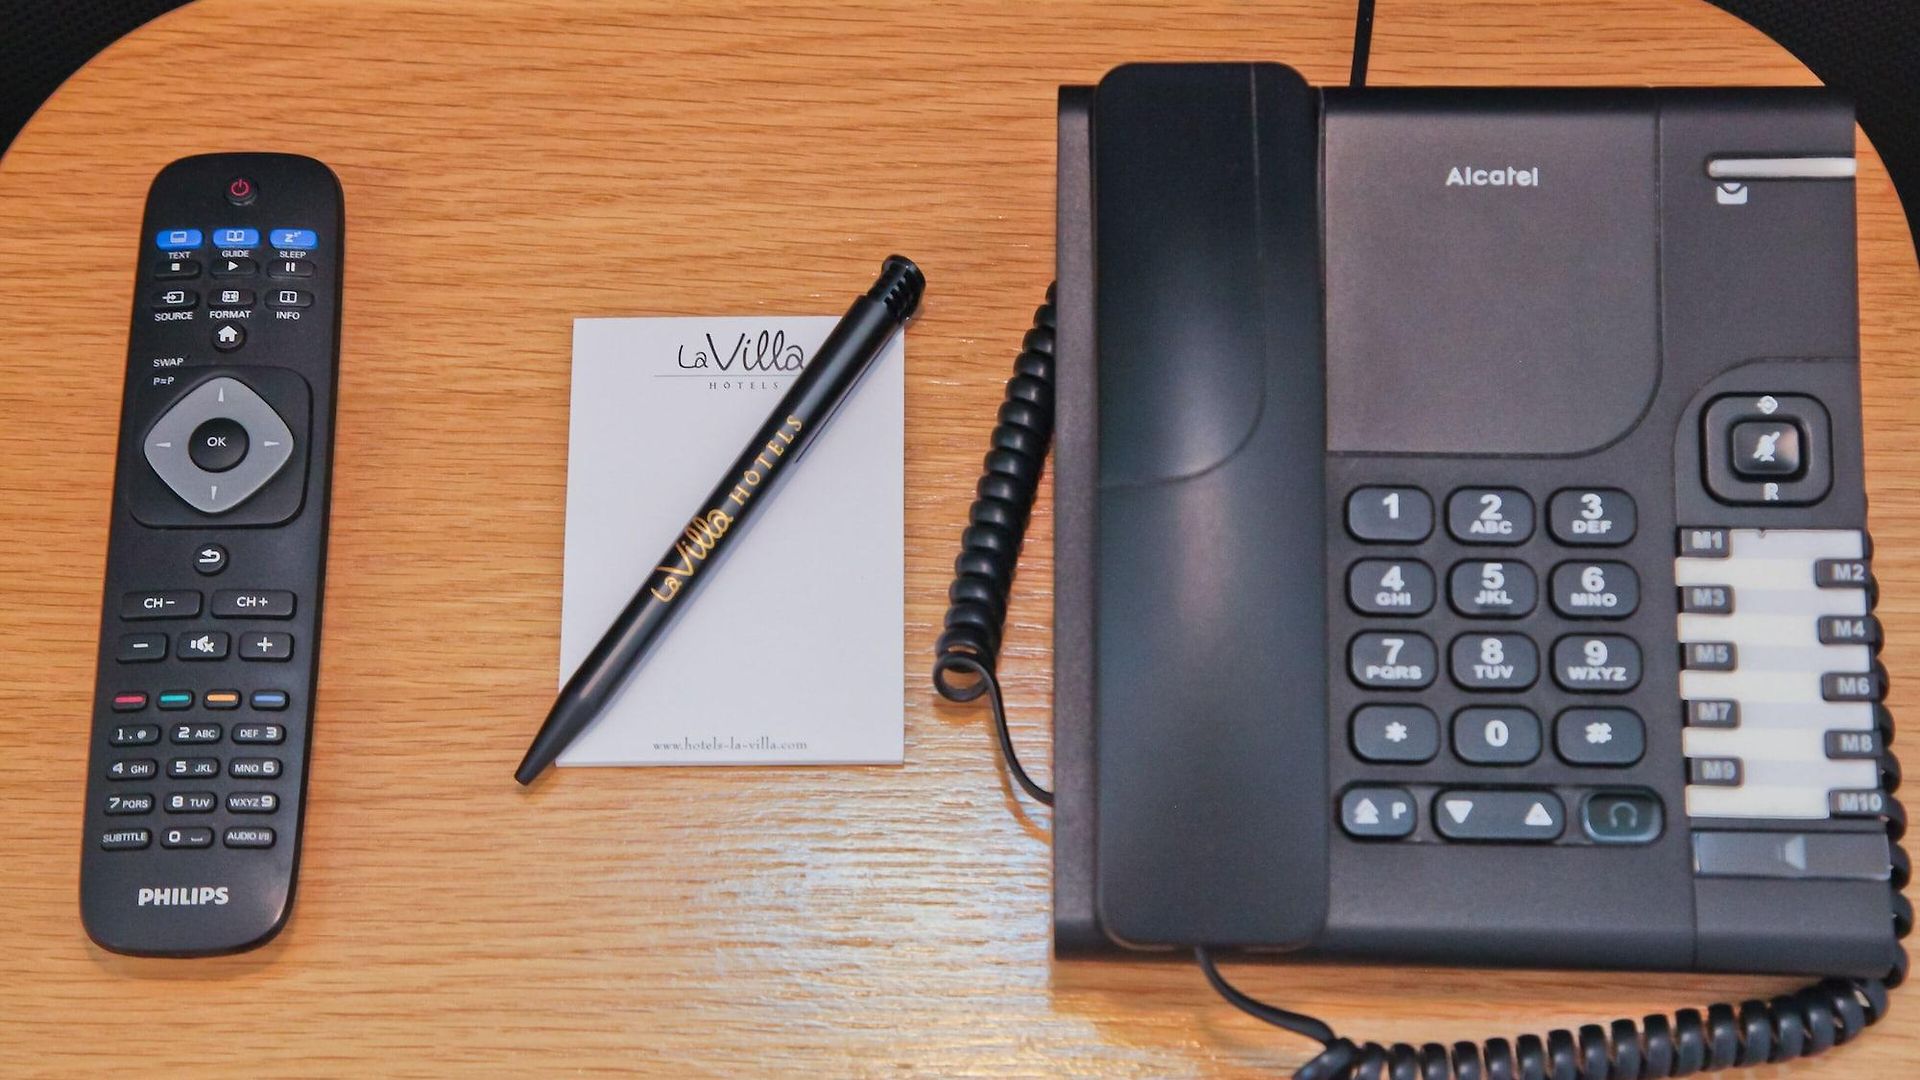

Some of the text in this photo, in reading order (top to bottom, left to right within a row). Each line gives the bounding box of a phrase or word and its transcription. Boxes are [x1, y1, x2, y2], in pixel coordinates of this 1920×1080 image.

[1446, 166, 1538, 186] Alcatel
[155, 312, 193, 321] SOURCE
[679, 330, 804, 370] La Villa
[154, 358, 183, 367] SWAP
[208, 437, 226, 446] OK
[1764, 483, 1778, 500] R
[1383, 493, 1398, 518] 1
[1480, 494, 1502, 520] 2
[1582, 494, 1603, 519] 3
[1470, 520, 1512, 534] ABC
[1572, 520, 1611, 533] DEF
[656, 509, 734, 576] Villa
[1692, 532, 1722, 548] M1
[1381, 566, 1404, 591] 4
[1483, 564, 1504, 589] 5
[1582, 567, 1604, 592] 6
[1834, 564, 1864, 580] M2
[651, 576, 682, 602] La
[1475, 590, 1513, 604] JKL
[1376, 592, 1410, 605] GHI
[1571, 593, 1617, 606] MNO
[1693, 589, 1724, 606] M3
[1834, 620, 1865, 636] M4
[1382, 639, 1404, 665] 7
[1481, 638, 1504, 664] 8
[1584, 640, 1607, 665] 9
[1696, 645, 1728, 662] M5
[1366, 666, 1422, 679] PQRS
[1474, 665, 1513, 679] TUV
[1568, 666, 1626, 681] WXYZ
[1838, 678, 1870, 694] M6
[1698, 703, 1730, 720] M7
[179, 727, 214, 738] 2 ABC
[240, 727, 276, 738] DEF 3
[1486, 720, 1508, 746] 0
[653, 736, 807, 750] www.hotels-la-villa.com
[1841, 734, 1872, 752] M8
[113, 763, 147, 774] 4 GHI
[176, 762, 186, 772] 5
[235, 762, 274, 773] MNO 6
[1702, 761, 1734, 778] M9
[110, 798, 148, 808] 7 PQRS
[172, 796, 183, 807] 8
[262, 796, 272, 807] 9
[1839, 794, 1882, 811] M10
[1392, 802, 1406, 818] P
[103, 832, 146, 842] SUBTITLE
[169, 831, 180, 842] 0
[228, 832, 256, 840] AUDIO
[138, 887, 228, 906] PHILIPS
